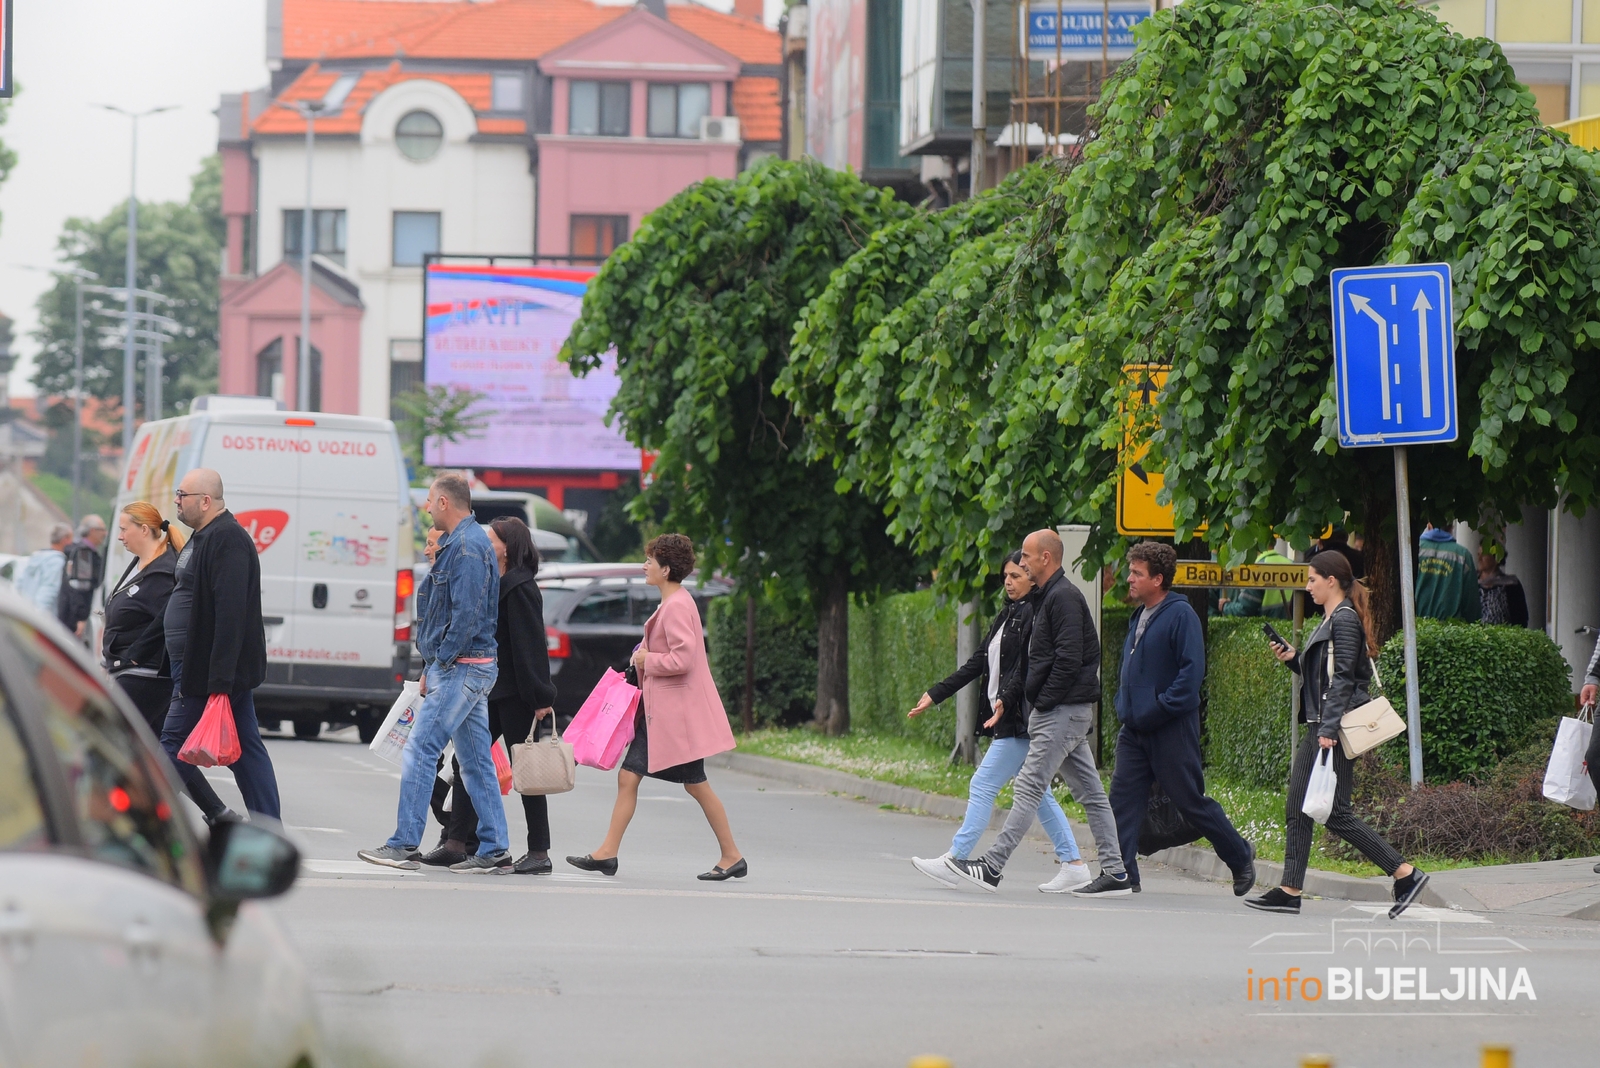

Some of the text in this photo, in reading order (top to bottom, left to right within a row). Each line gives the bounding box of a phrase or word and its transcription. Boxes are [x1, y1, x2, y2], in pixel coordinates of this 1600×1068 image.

[1035, 14, 1140, 31] СИНДИКАТ
[222, 435, 377, 456] DOSTAVNO VOZILO
[1186, 566, 1304, 585] Banja Dvorovi
